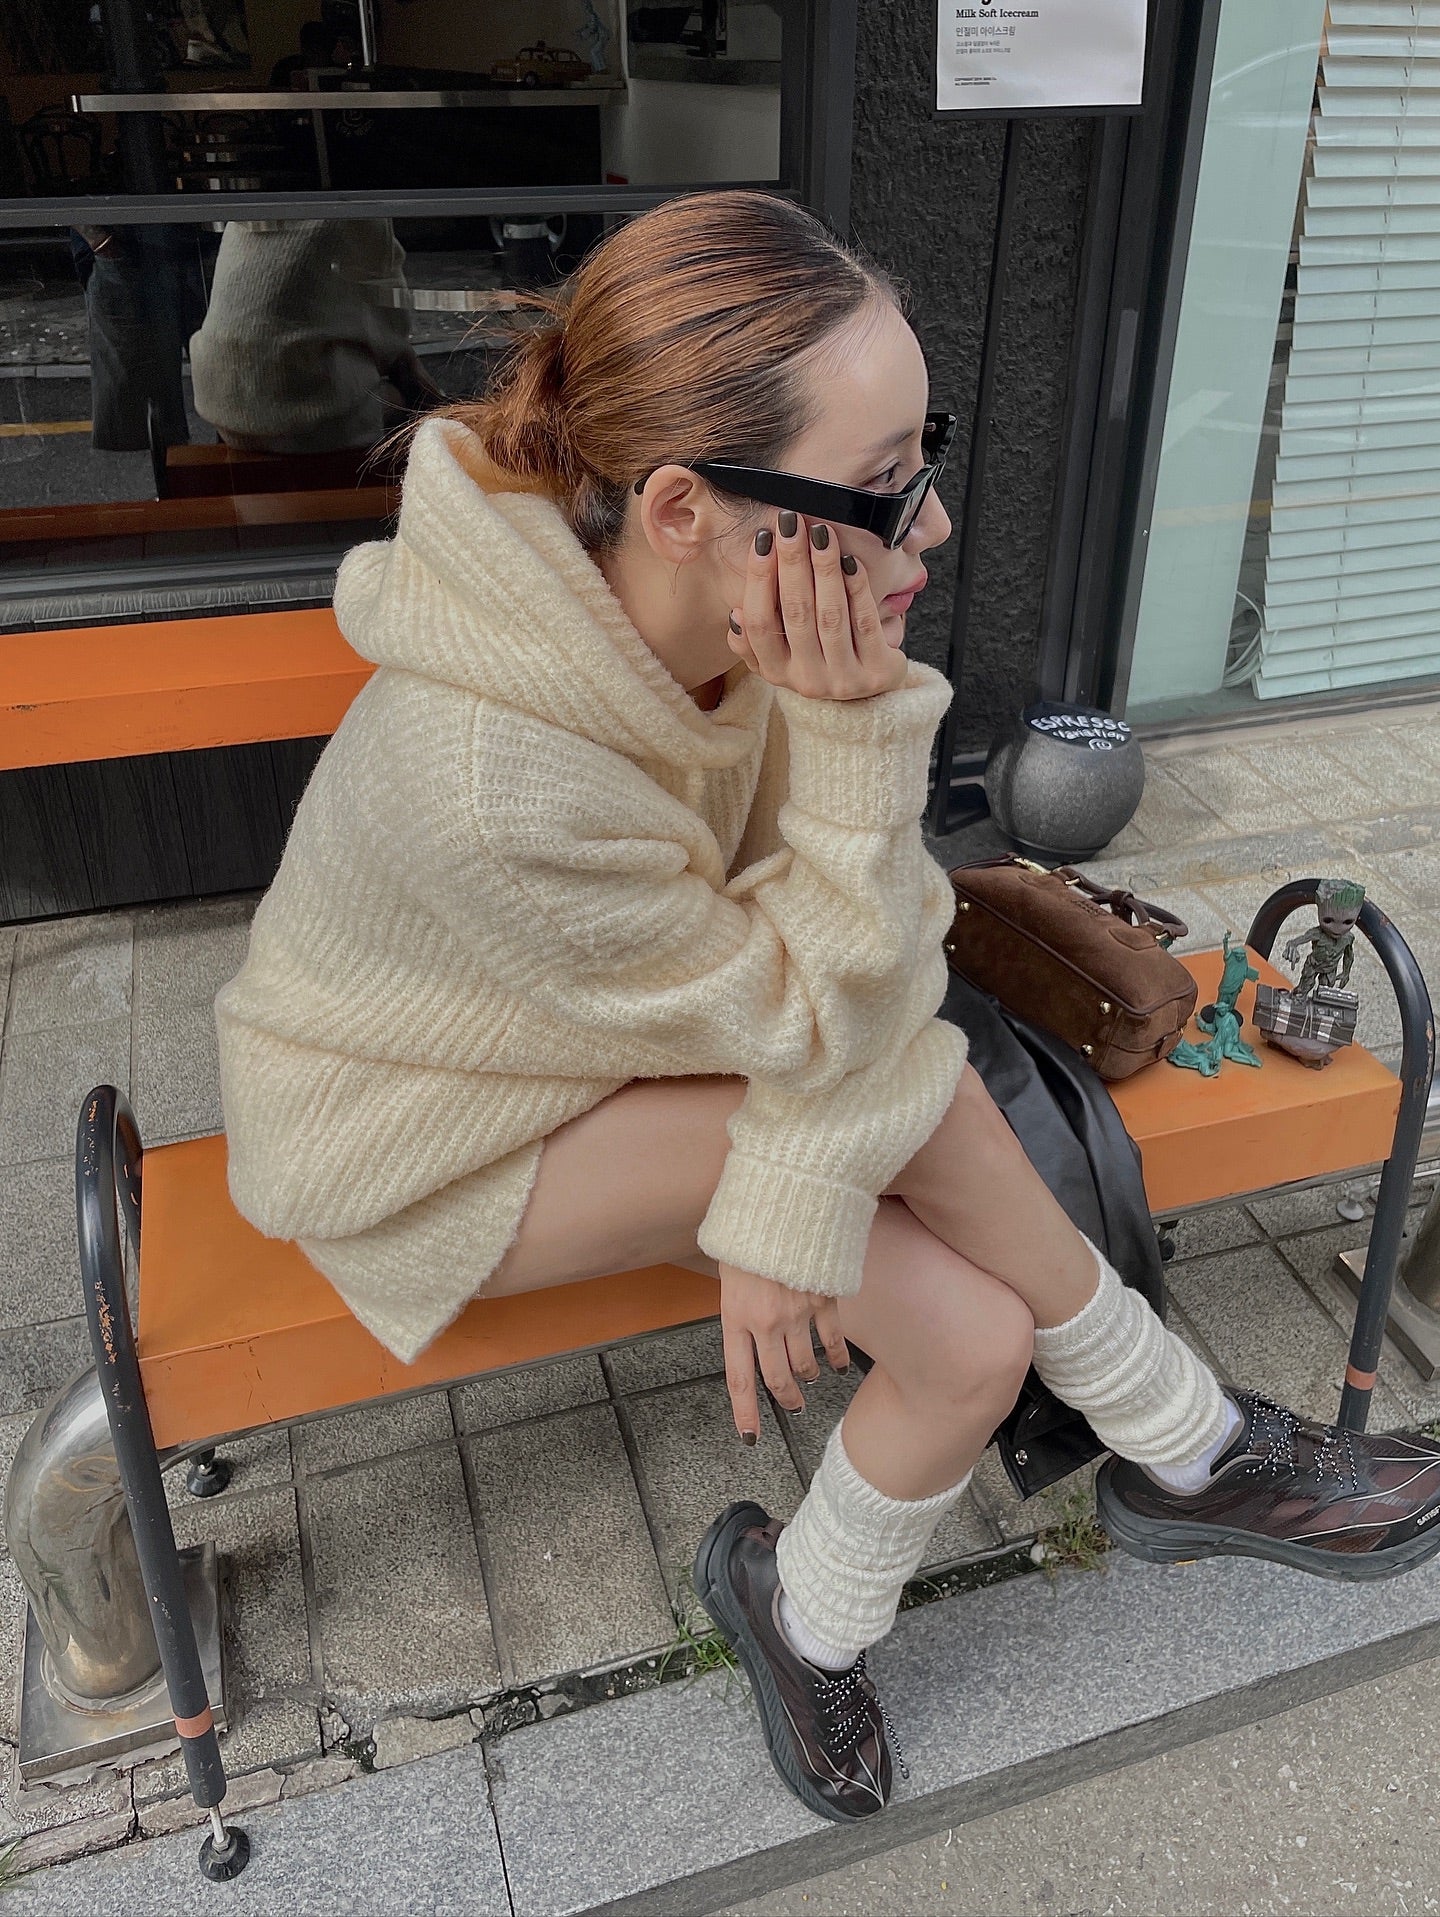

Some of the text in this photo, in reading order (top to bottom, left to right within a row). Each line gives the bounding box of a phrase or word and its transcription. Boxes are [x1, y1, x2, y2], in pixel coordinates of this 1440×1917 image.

[956, 8, 1039, 18] Milk Soft Icecream
[956, 26, 1016, 37] 인절미 아이스크림
[1416, 1504, 1440, 1526] SATISF
